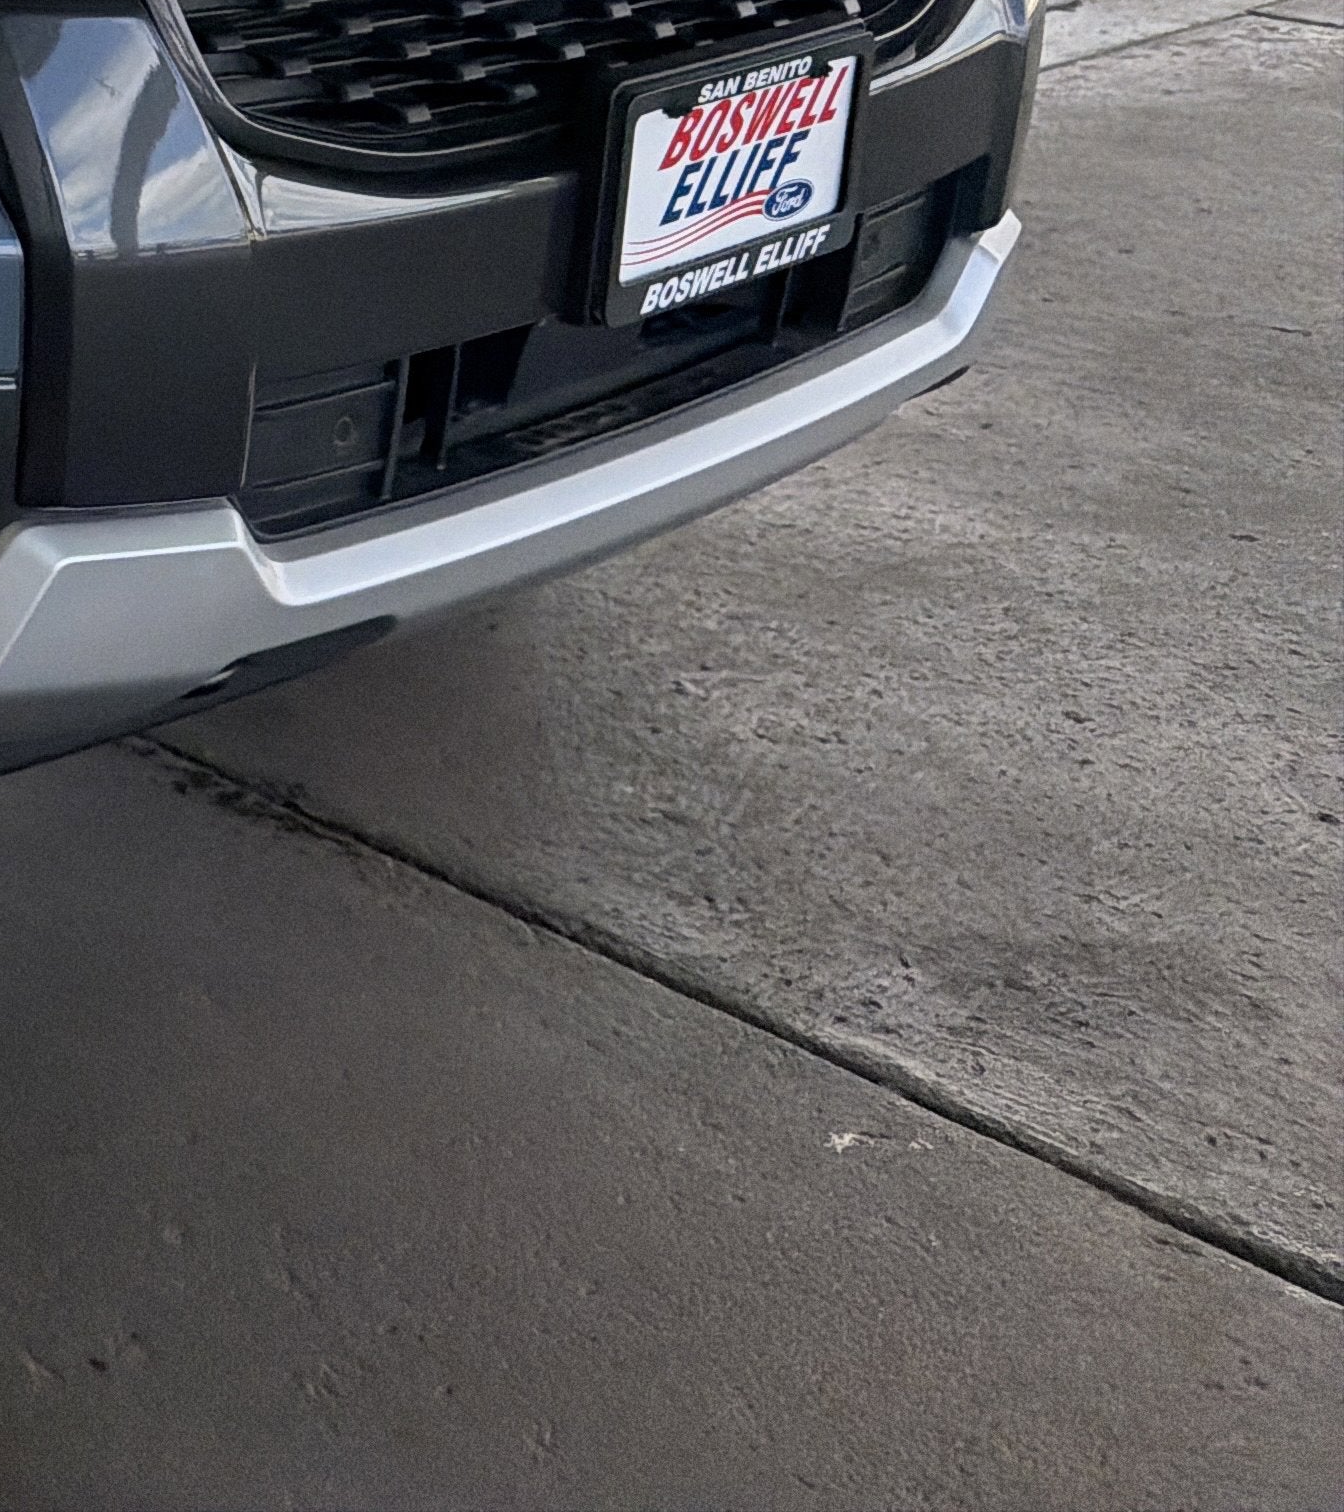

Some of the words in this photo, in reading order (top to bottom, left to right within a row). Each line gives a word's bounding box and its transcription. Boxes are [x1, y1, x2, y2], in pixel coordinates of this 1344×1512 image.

[658, 65, 850, 170] BOSWELL
[698, 76, 742, 103] SAN
[743, 56, 812, 92] BENITO
[659, 129, 811, 227] ELLIFF
[771, 185, 806, 216] Ford
[640, 252, 749, 315] BOSWELL
[753, 224, 831, 276] ELLIFF
